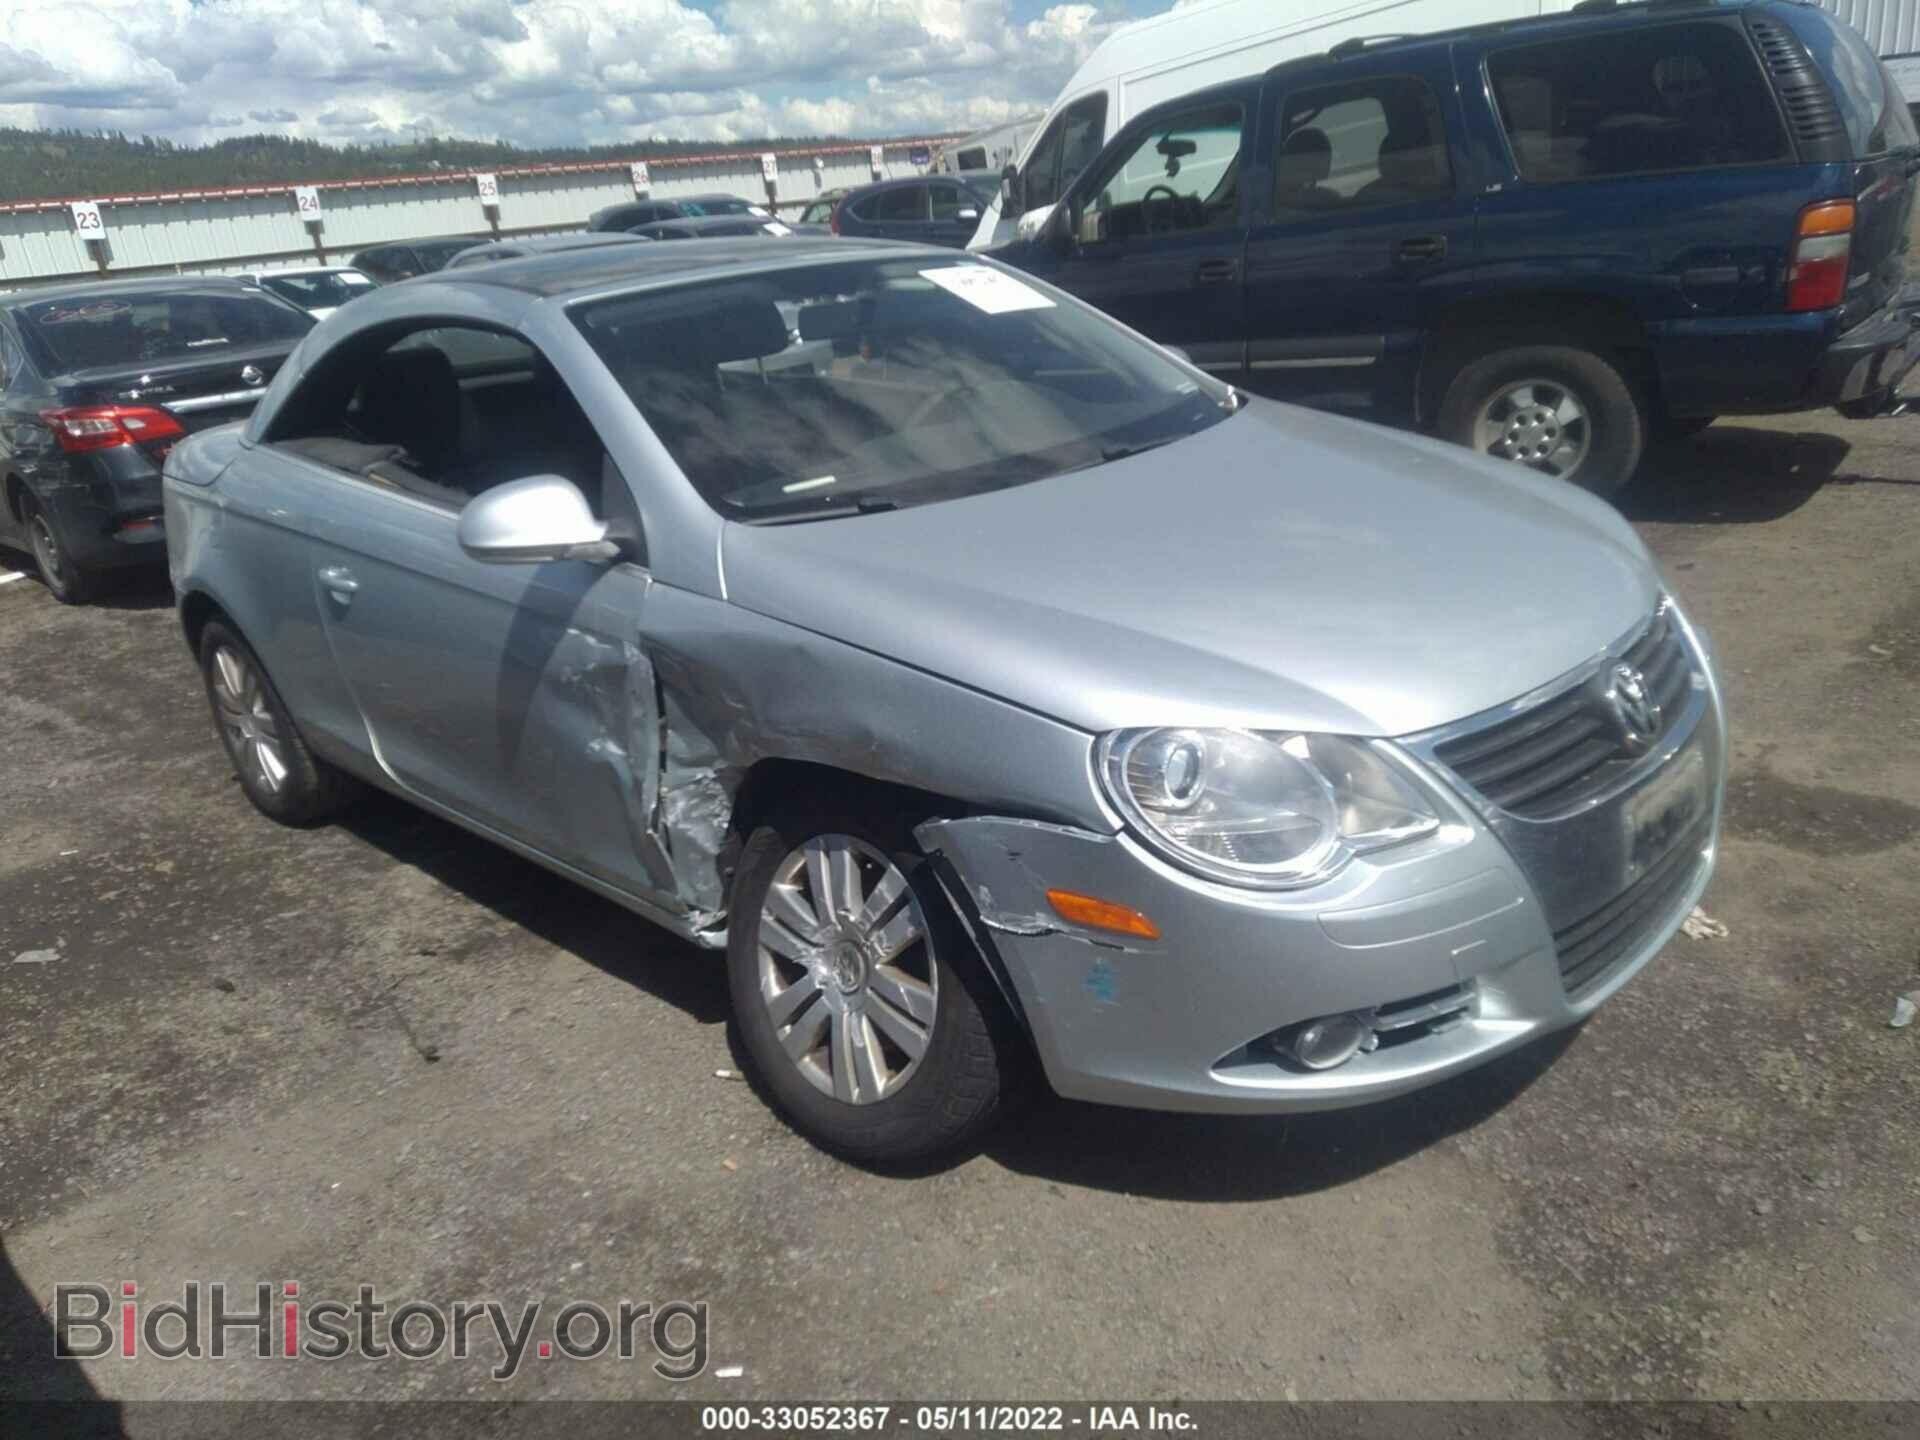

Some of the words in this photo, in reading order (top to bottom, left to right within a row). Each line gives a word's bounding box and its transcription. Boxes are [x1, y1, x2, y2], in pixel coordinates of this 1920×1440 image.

[480, 182, 496, 196] 25
[299, 195, 318, 211] 24
[77, 211, 101, 229] 23
